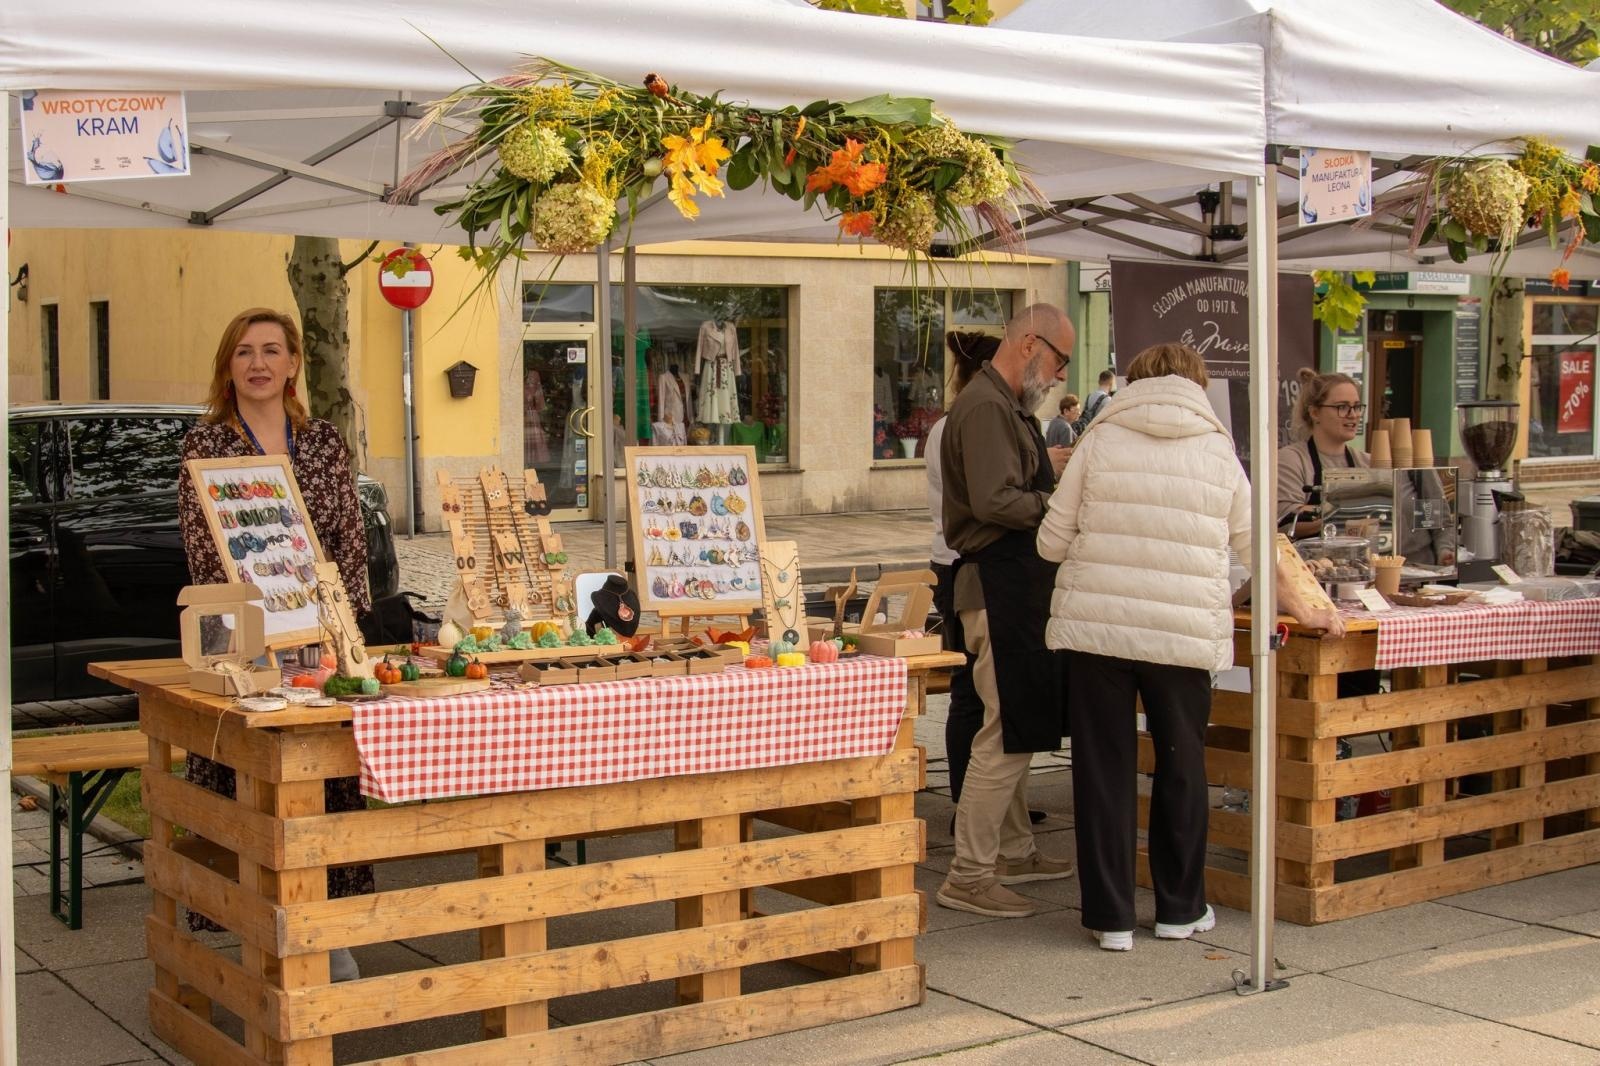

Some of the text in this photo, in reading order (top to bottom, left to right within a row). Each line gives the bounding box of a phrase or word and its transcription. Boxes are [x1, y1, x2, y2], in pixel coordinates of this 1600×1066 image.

[42, 97, 166, 115] WROTYCZOWY
[76, 116, 139, 136] KRAM
[1323, 155, 1354, 168] SŁODKA
[1311, 168, 1363, 182] MANUFAKTURA
[1327, 181, 1351, 192] LEONA
[1152, 276, 1250, 318] SŁODKA MANUFAKTURA
[1197, 299, 1239, 314] OD 1917 R.
[1561, 360, 1590, 374] SALE
